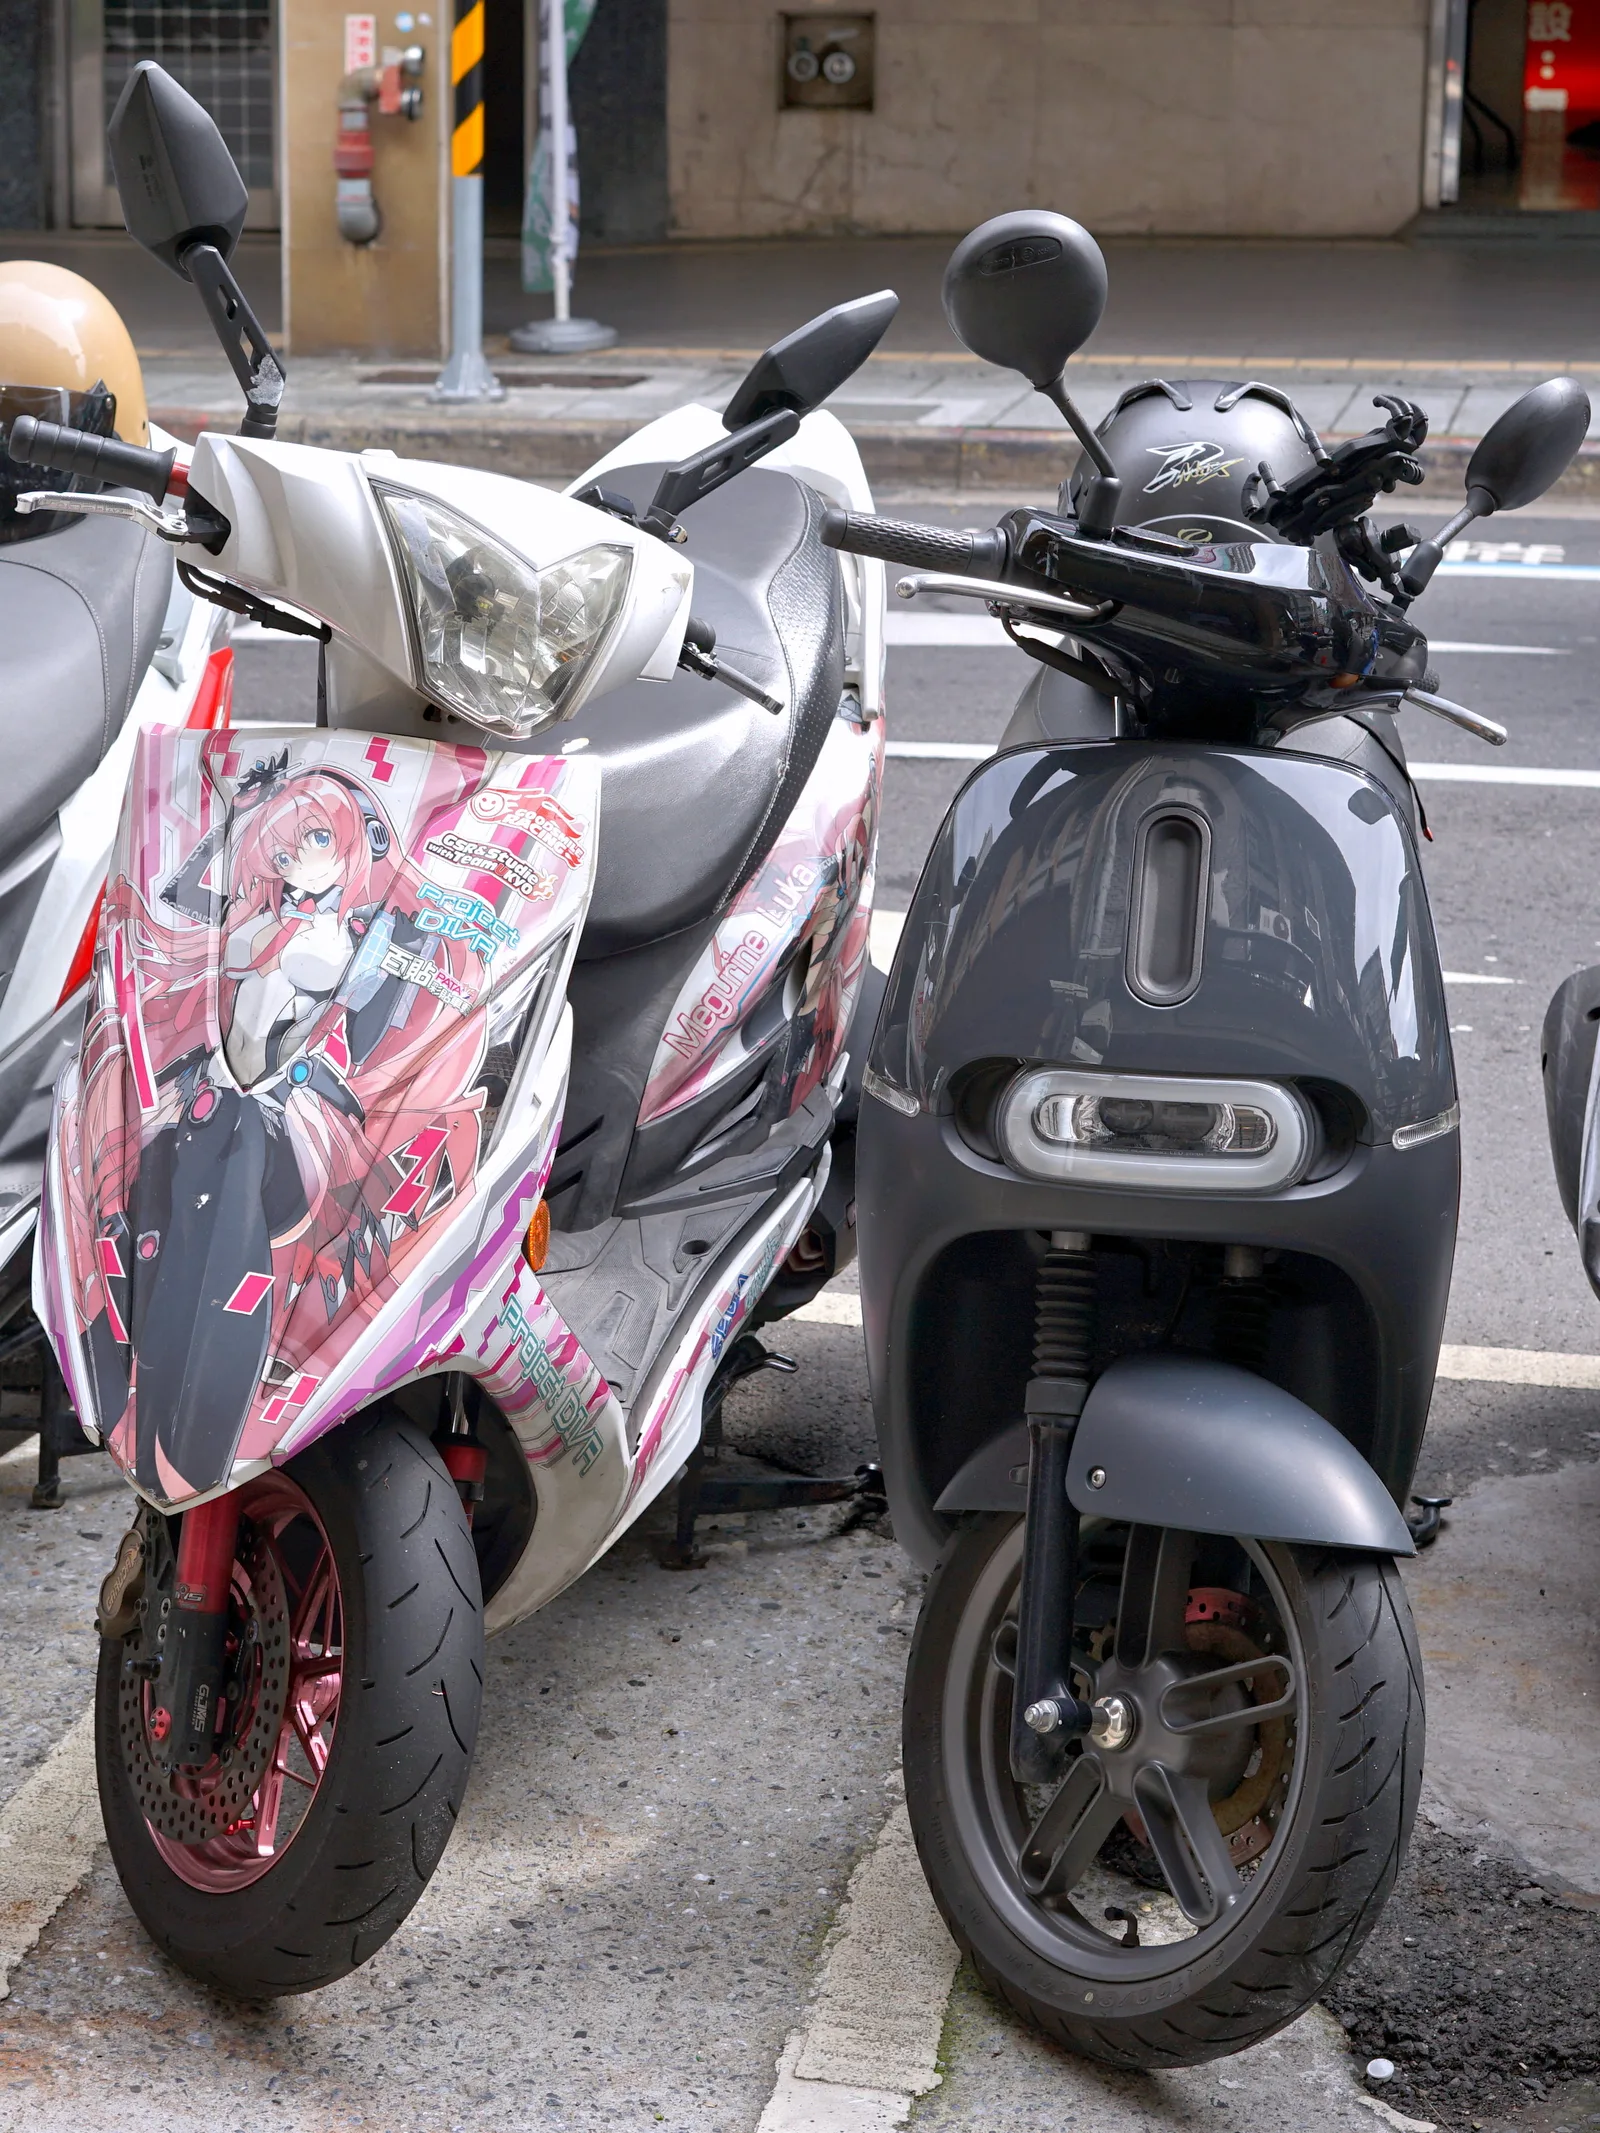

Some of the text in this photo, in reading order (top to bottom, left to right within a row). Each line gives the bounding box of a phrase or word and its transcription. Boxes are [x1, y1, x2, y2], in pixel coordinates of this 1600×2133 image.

[501, 814, 567, 855] RACING
[416, 882, 520, 949] Project
[754, 863, 817, 928] Luka
[414, 908, 497, 963] DIVA
[435, 972, 461, 996] PATA
[662, 929, 770, 1059] Megurine
[500, 1293, 604, 1478] Project DIVA
